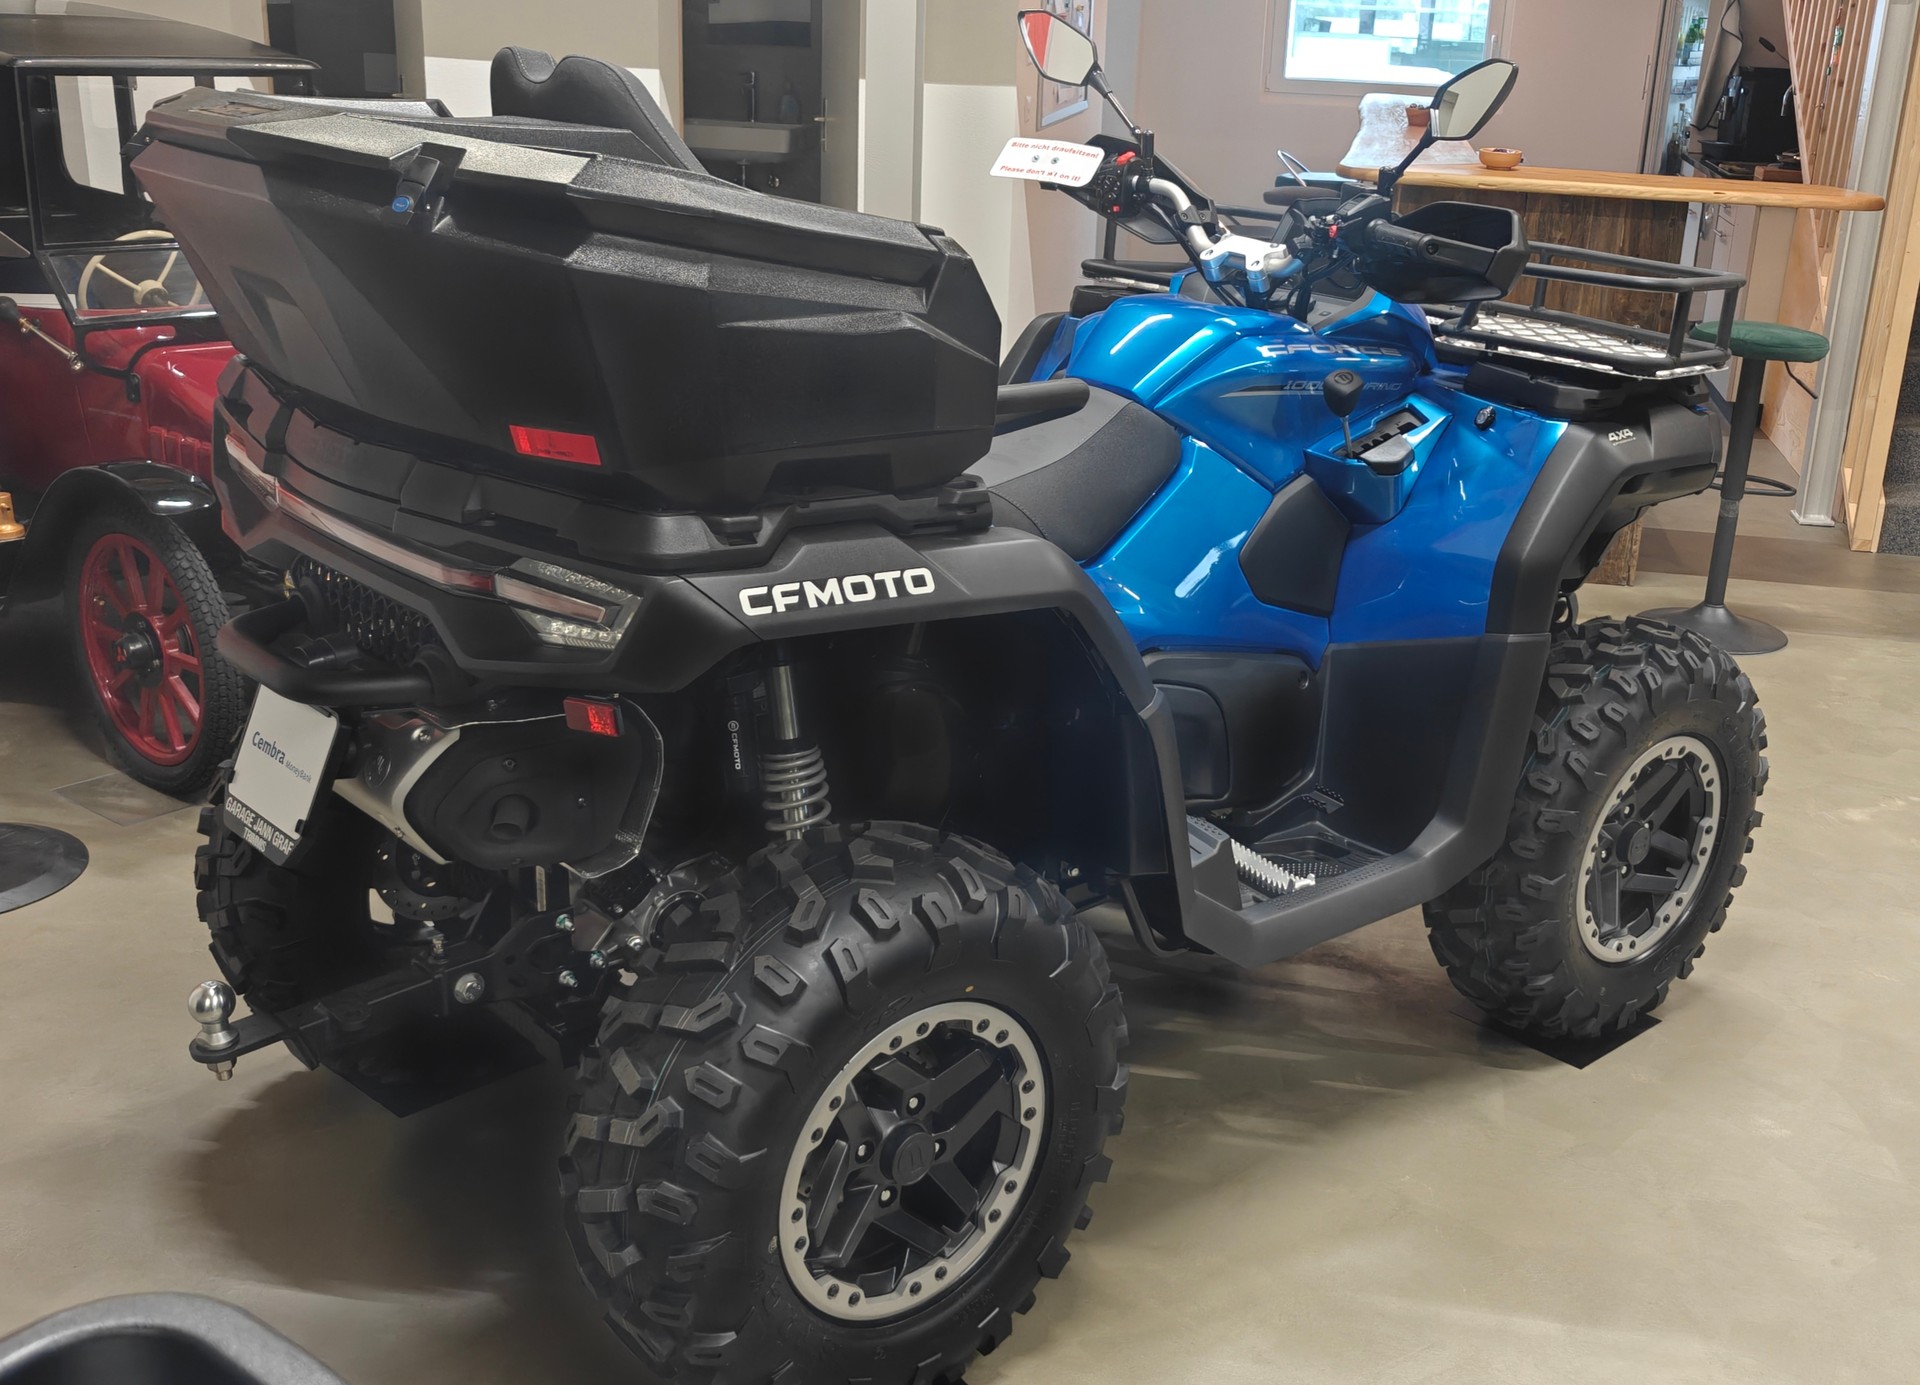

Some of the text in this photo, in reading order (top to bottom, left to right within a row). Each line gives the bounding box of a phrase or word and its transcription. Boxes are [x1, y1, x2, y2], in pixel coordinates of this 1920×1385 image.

[1030, 142, 1050, 151] nicht
[1051, 145, 1100, 159] draufsitzen!
[1000, 165, 1025, 173] Please
[1026, 168, 1045, 176] don't
[1257, 344, 1402, 357] CFORCE
[738, 567, 936, 617] CFMOTO
[252, 731, 286, 765] Cembra
[731, 732, 741, 770] CFMOTO
[225, 796, 295, 856] GARAGE JANN GRAF
